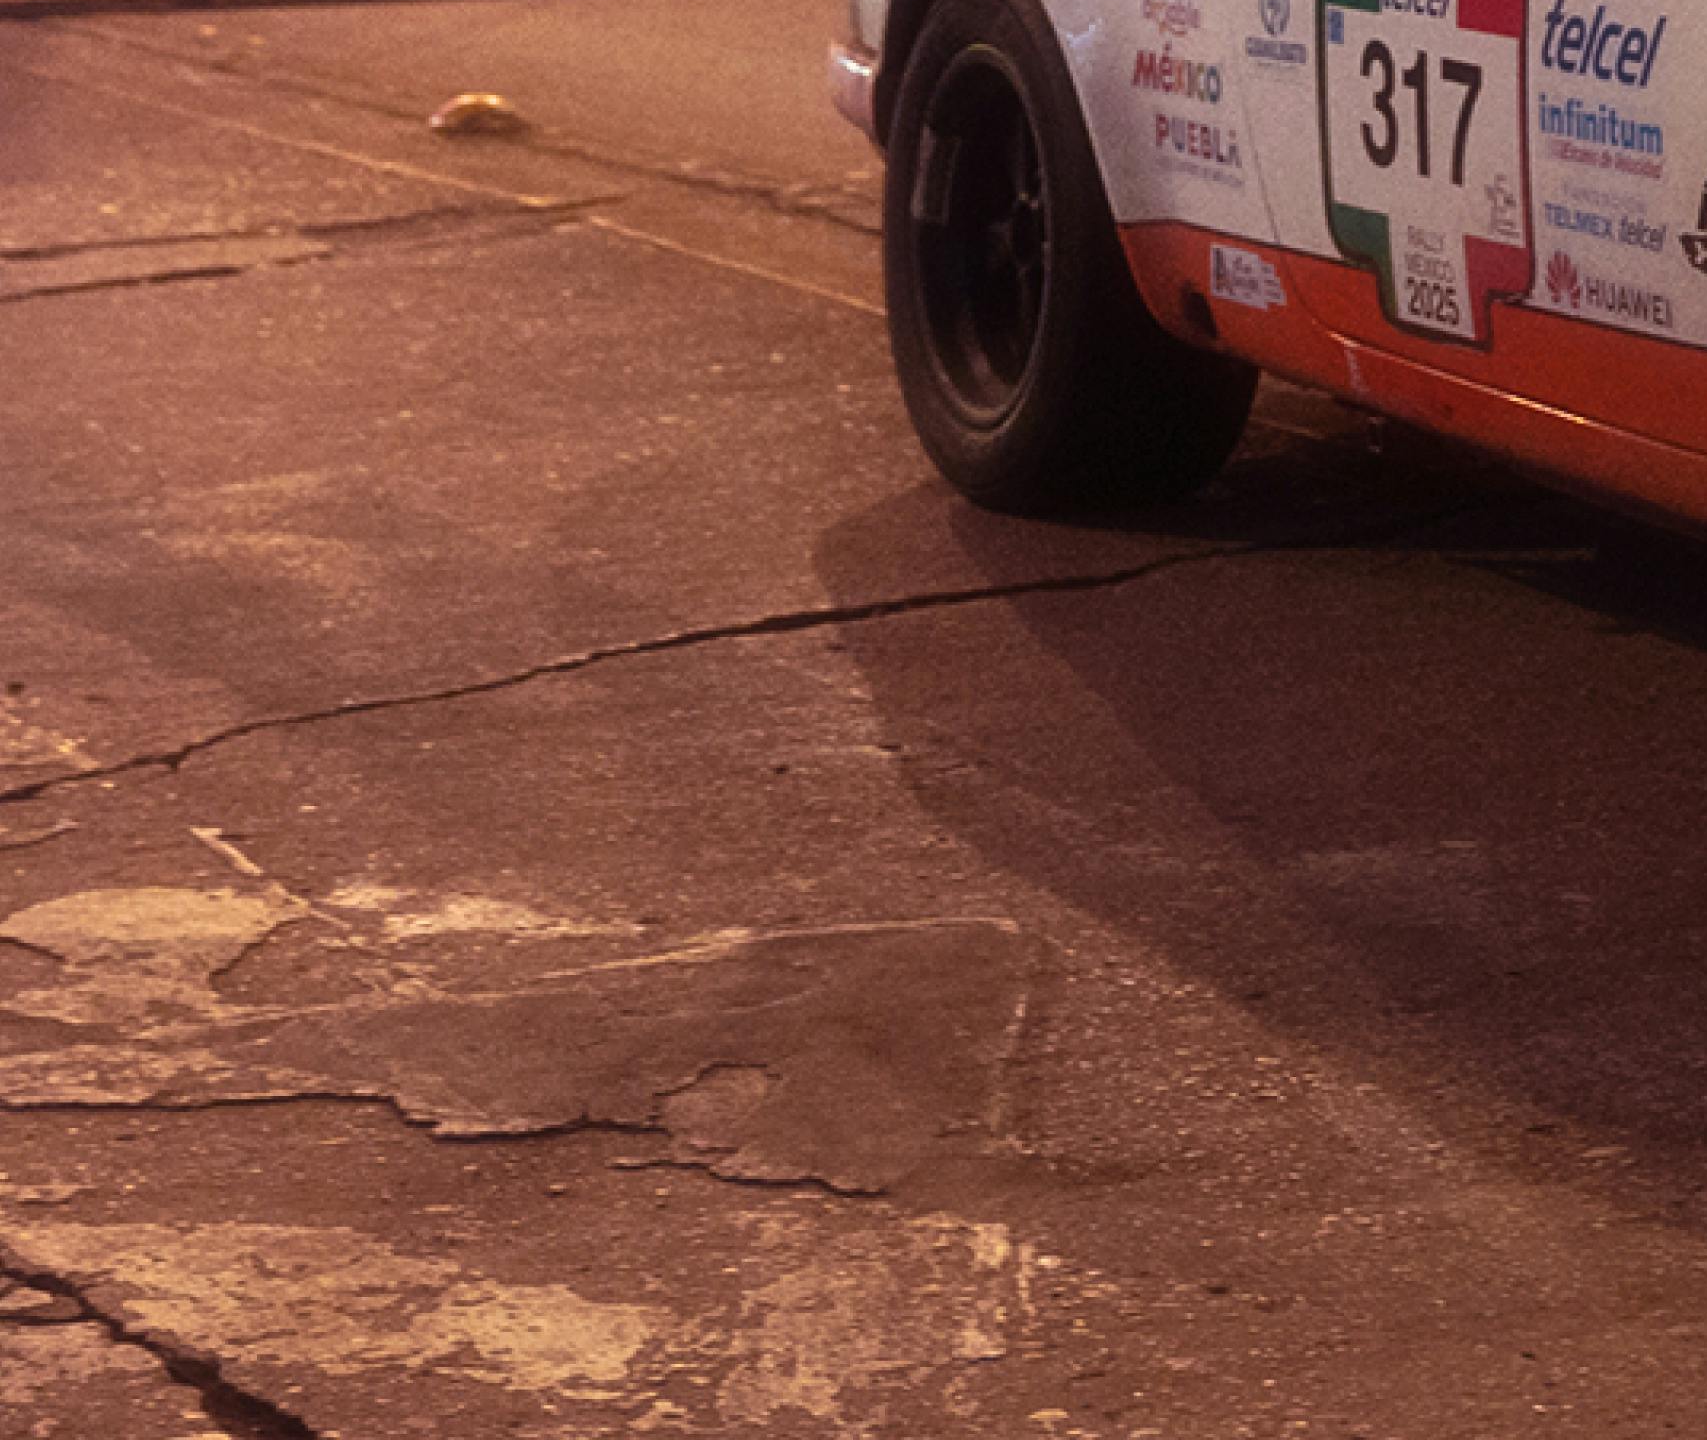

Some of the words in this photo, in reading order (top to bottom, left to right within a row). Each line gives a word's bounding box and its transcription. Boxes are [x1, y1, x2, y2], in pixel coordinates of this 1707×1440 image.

[1359, 38, 1484, 188] 317
[1538, 91, 1664, 156] infinitum
[1619, 215, 1668, 253] telcel
[1406, 276, 1461, 326] 2025
[1585, 274, 1674, 329] HUAWEI
